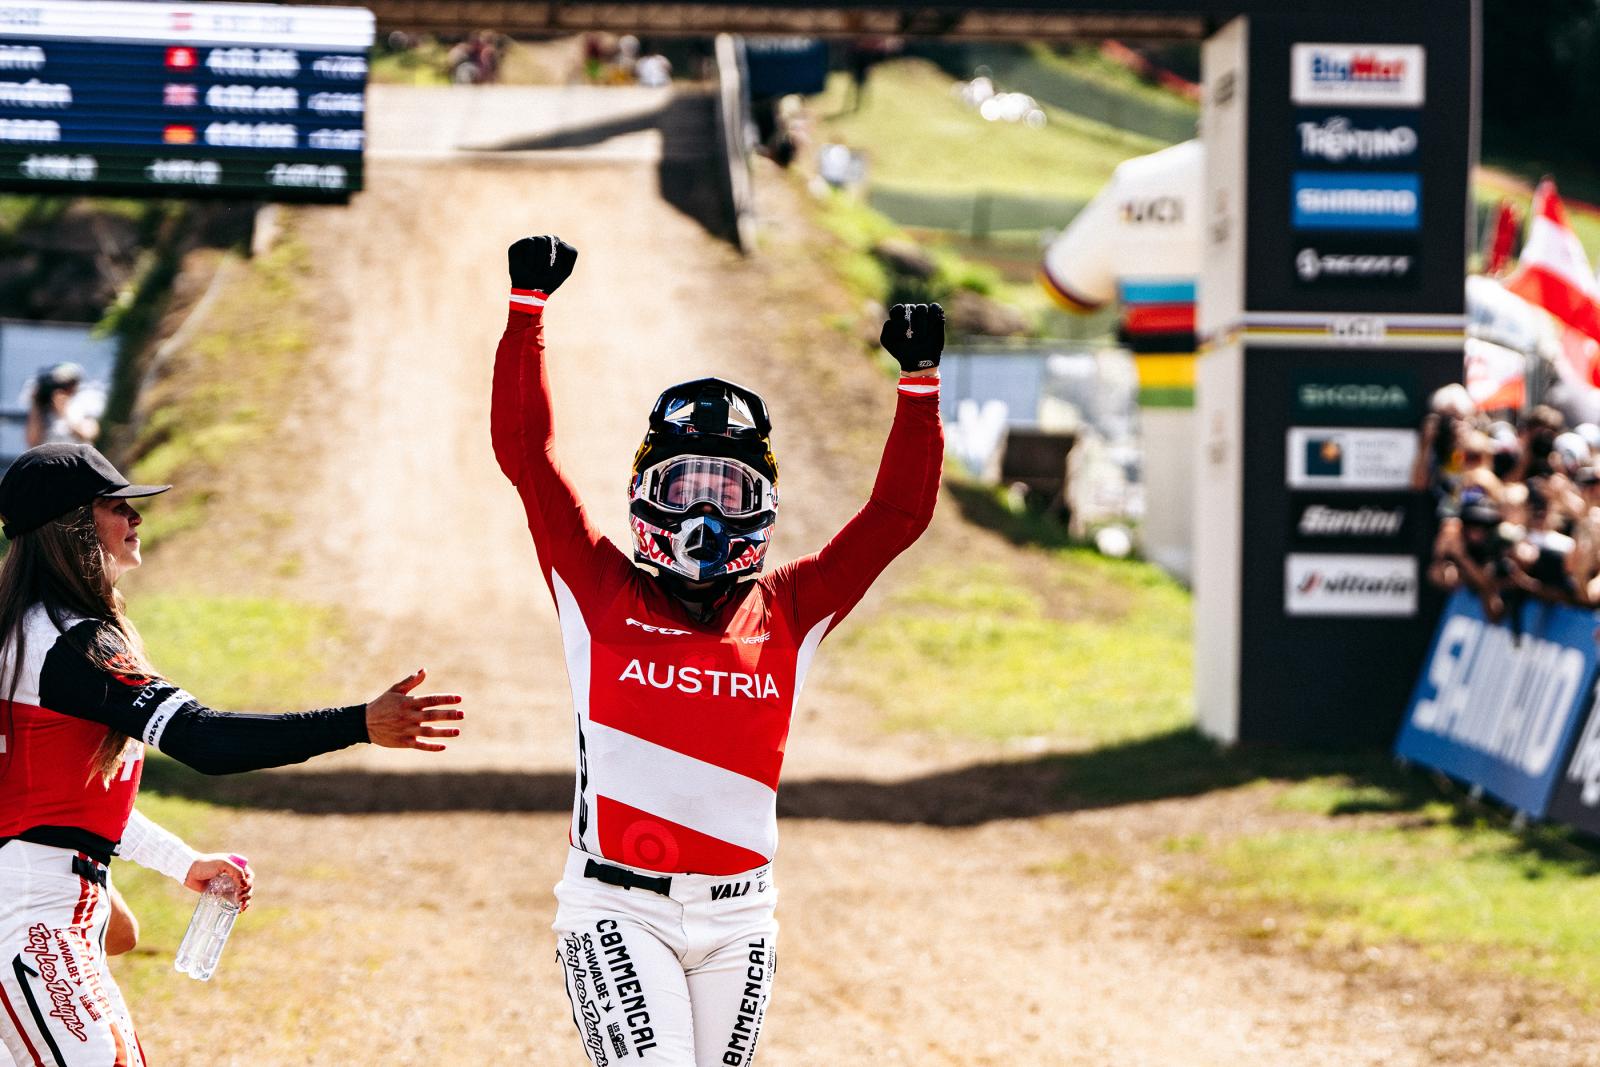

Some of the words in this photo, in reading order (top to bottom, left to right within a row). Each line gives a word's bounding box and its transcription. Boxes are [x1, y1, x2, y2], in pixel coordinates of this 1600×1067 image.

[618, 658, 780, 699] AUSTRIA
[35, 953, 59, 983] Lee
[581, 932, 610, 1001] SCHWALBE
[722, 937, 765, 1067] OMMENCAL
